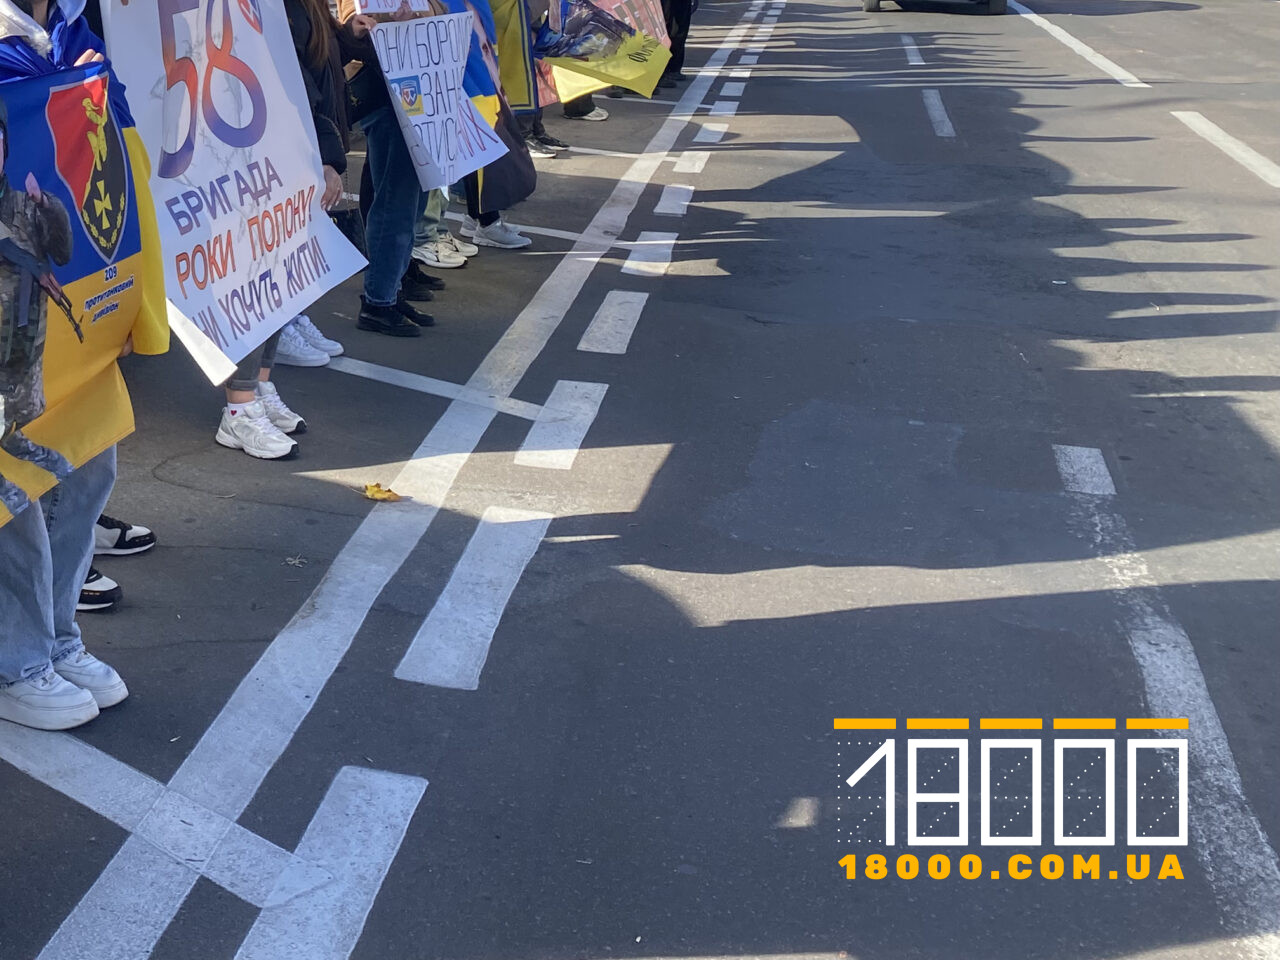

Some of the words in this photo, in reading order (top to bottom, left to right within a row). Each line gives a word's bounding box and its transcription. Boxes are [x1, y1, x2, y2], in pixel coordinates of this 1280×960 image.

[373, 25, 414, 73] ОНИ
[165, 157, 283, 235] БРИГАДА
[104, 265, 118, 282] 209
[176, 229, 236, 300] РОКИ
[218, 268, 282, 340] ХОЧУТЬ
[284, 236, 330, 299] ЖИТИ!
